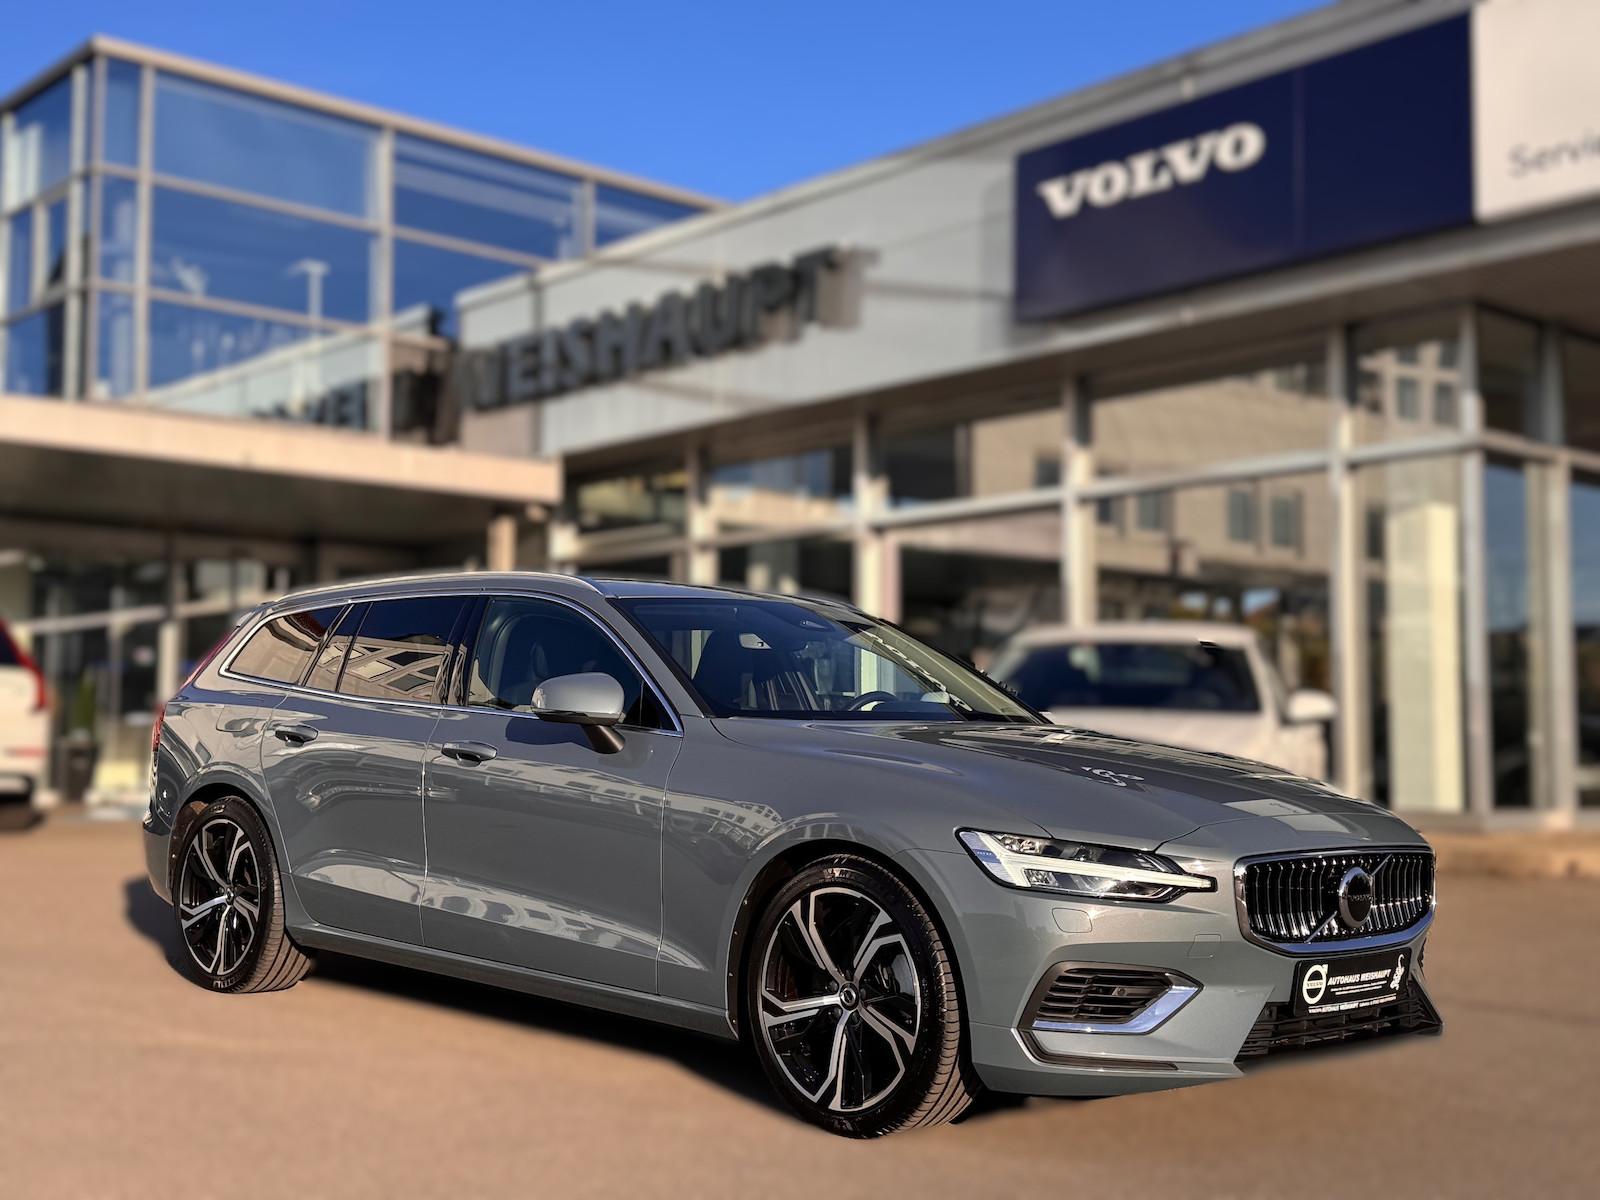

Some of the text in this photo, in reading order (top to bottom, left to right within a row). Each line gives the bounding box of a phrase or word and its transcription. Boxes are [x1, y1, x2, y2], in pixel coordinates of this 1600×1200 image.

[1037, 122, 1267, 219] VOLVO
[455, 246, 850, 416] WEISHAUPT
[1327, 974, 1360, 986] AUTOHAUS
[1360, 969, 1392, 982] WEISHAUPT
